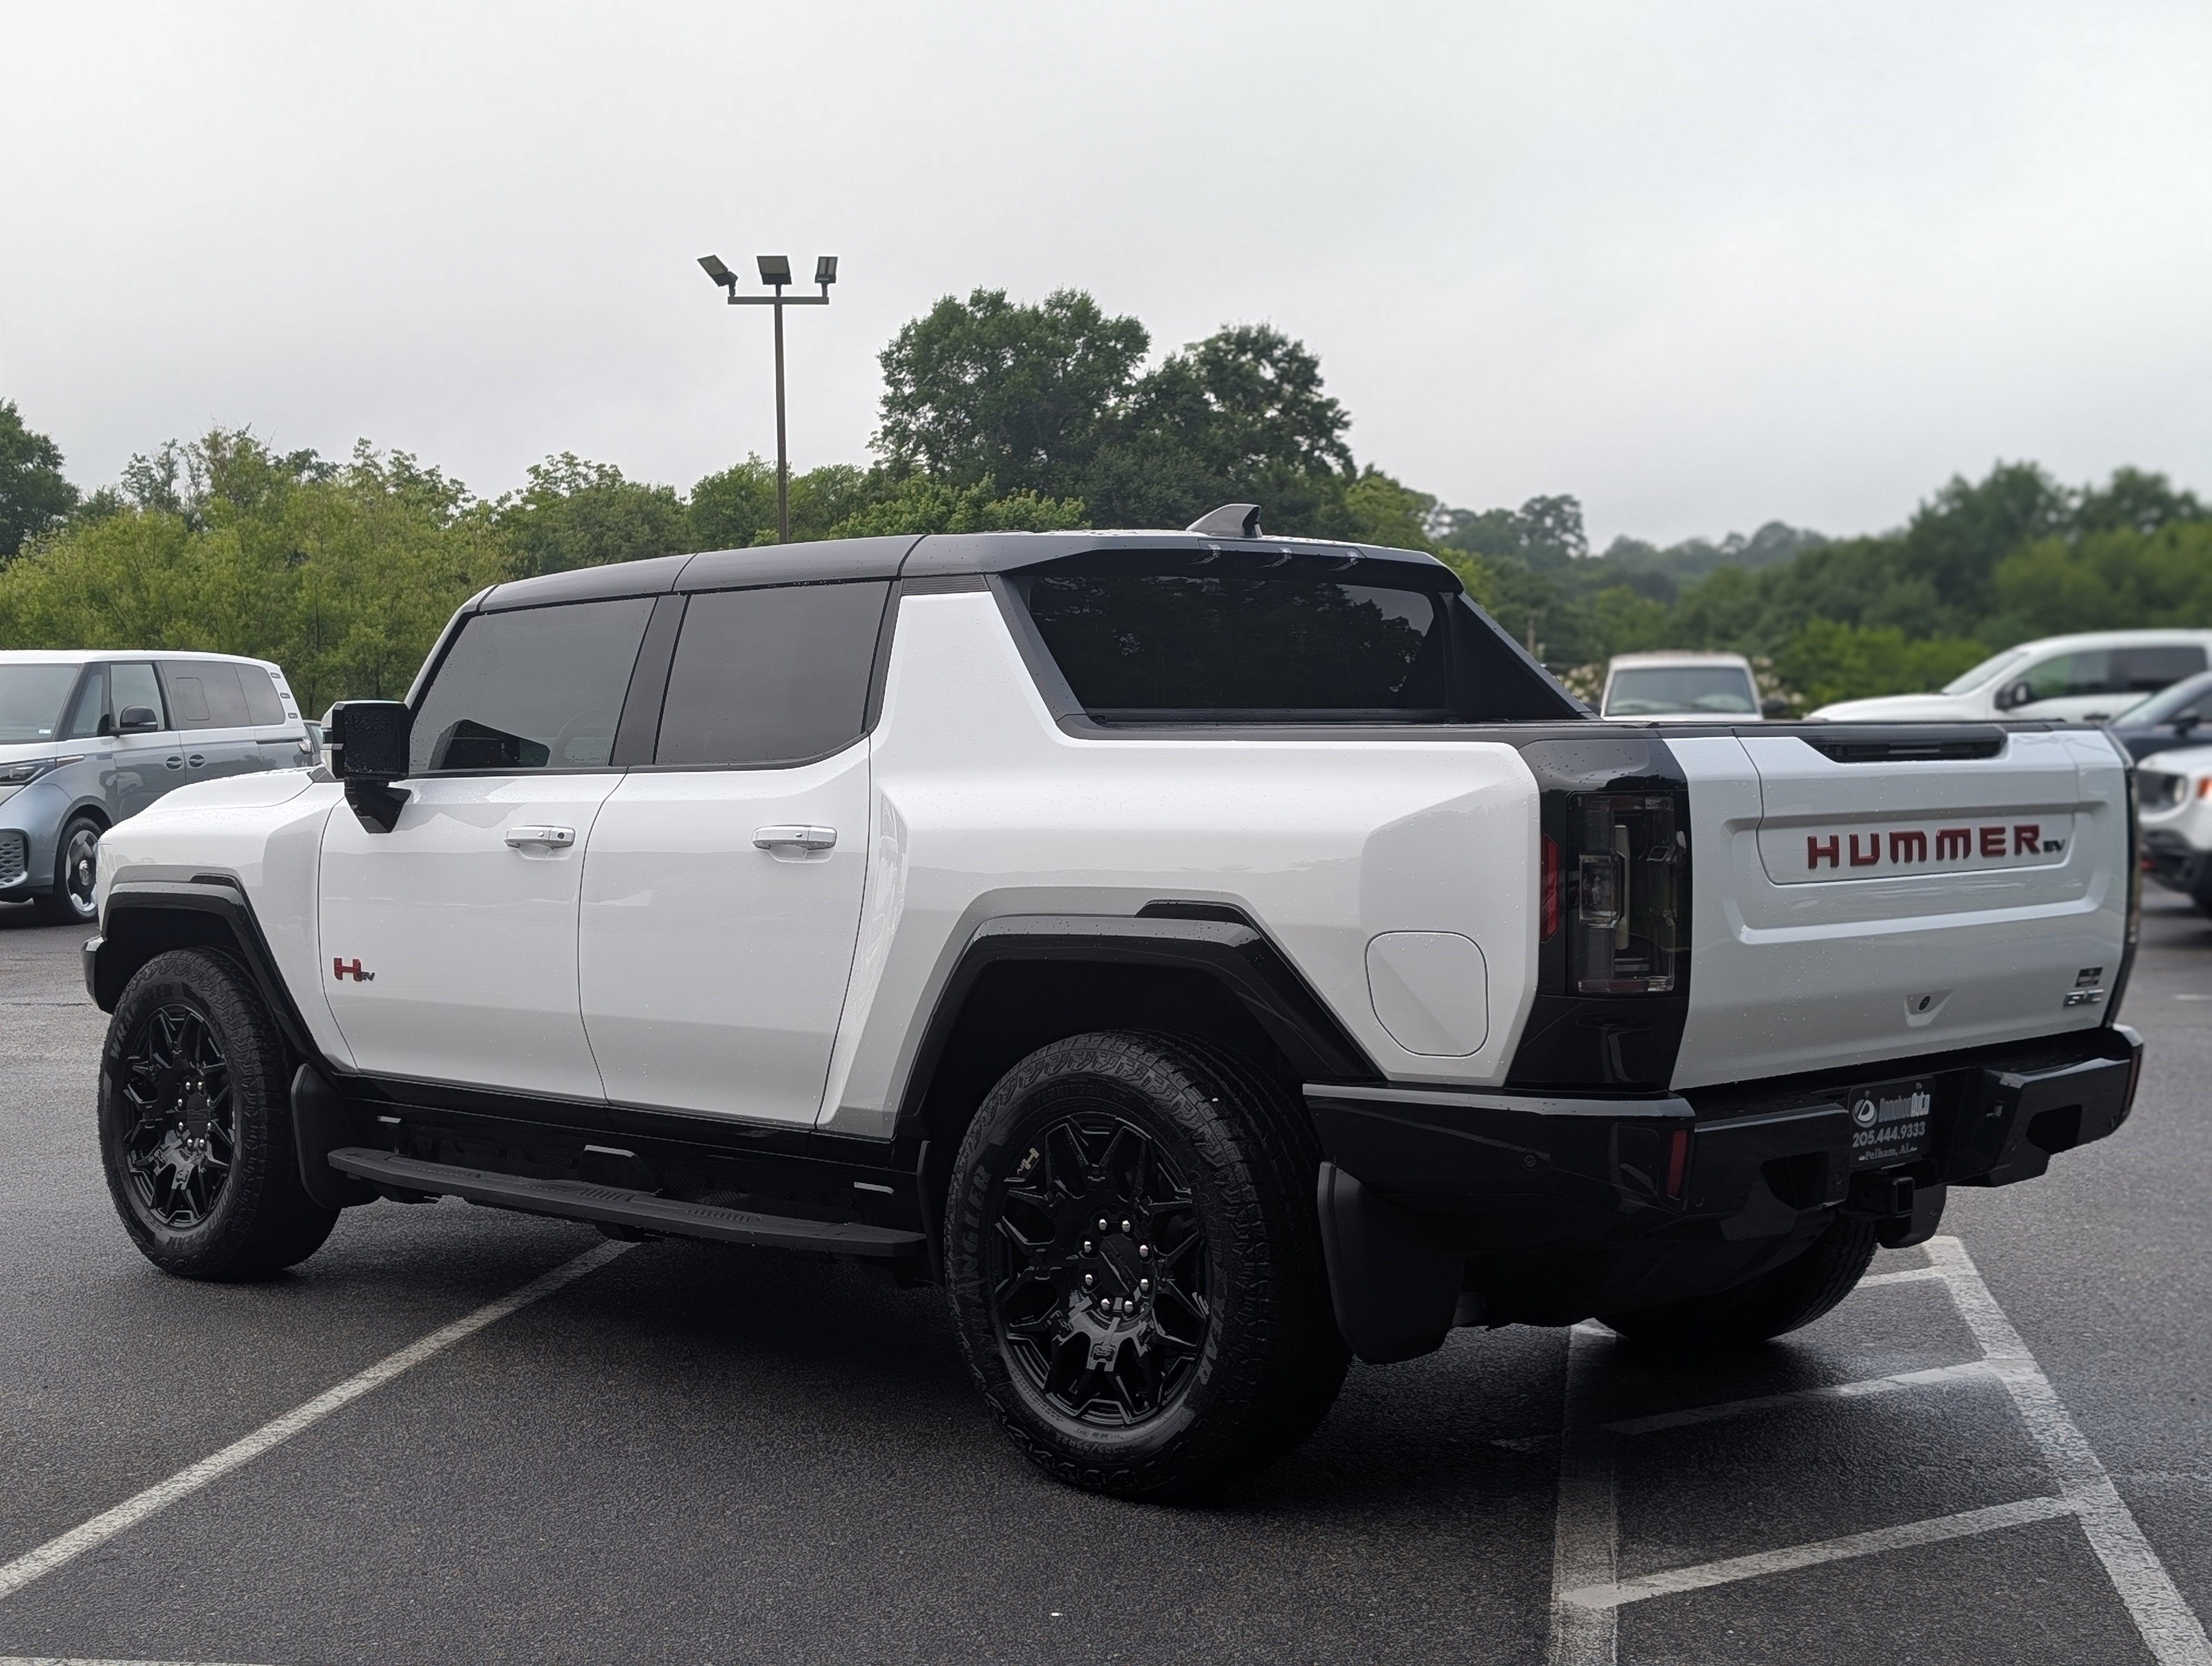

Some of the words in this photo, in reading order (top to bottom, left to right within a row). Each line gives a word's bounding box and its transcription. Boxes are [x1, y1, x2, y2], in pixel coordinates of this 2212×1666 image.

[1807, 824, 2040, 869] HUMMER
[2043, 839, 2066, 853] EV
[333, 957, 362, 982] H
[1853, 1122, 1926, 1148] 205.444.9333
[1865, 1147, 1899, 1161] Pelham,
